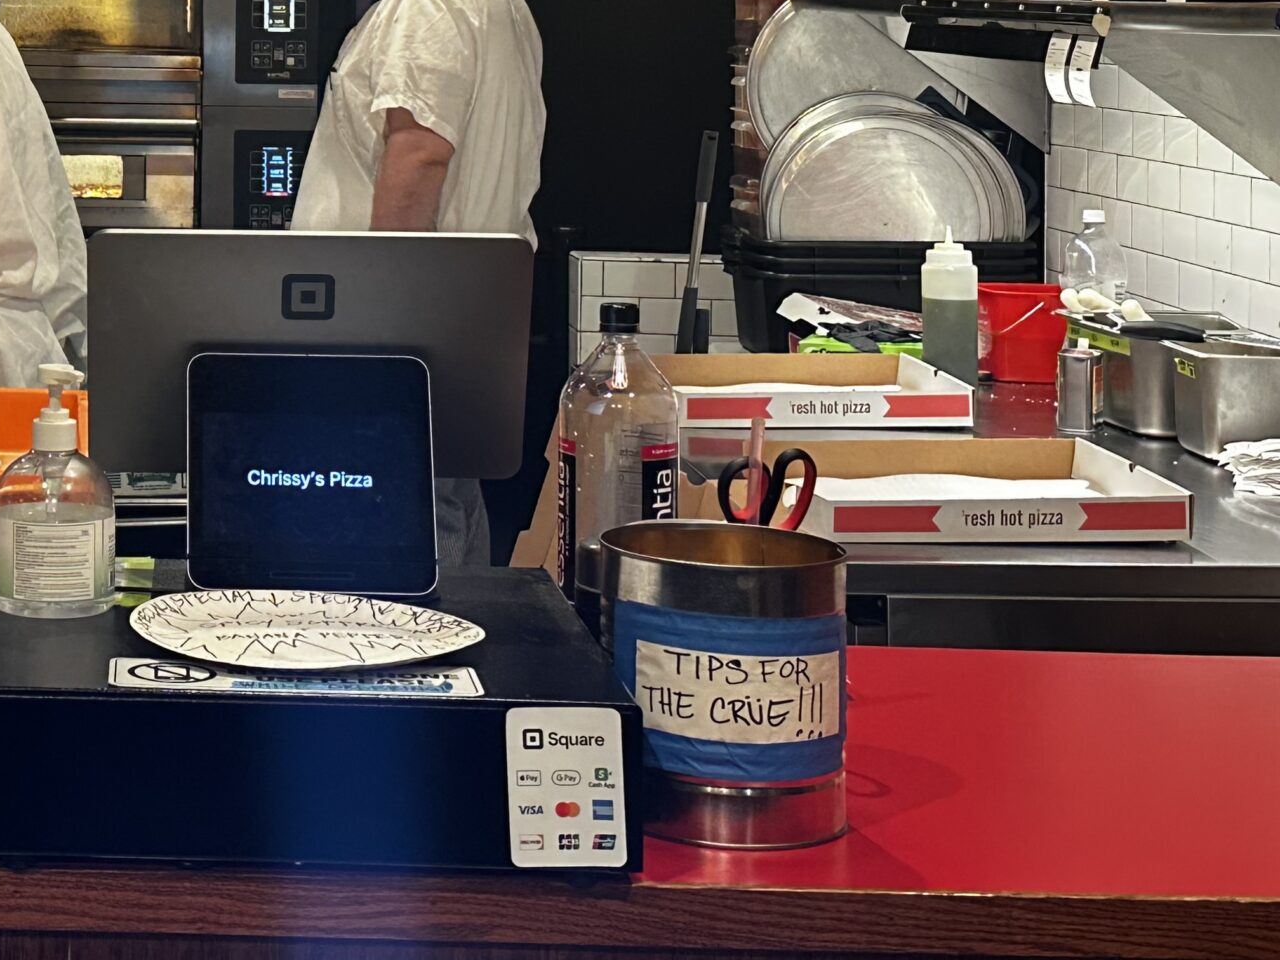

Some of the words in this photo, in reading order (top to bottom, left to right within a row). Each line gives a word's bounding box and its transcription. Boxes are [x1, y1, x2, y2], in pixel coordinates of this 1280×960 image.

[790, 399, 817, 415] resh
[820, 399, 839, 415] hot
[842, 399, 872, 418] pizza
[247, 469, 325, 490] Chrissy's
[329, 471, 373, 488] Pizza
[962, 508, 996, 528] resh
[1000, 507, 1023, 528] hot
[1028, 507, 1064, 530] pizza
[664, 649, 749, 685] TIPS
[759, 657, 811, 685] FOR
[642, 685, 696, 719] THE
[548, 732, 605, 749] Square
[518, 805, 544, 815] VISA
